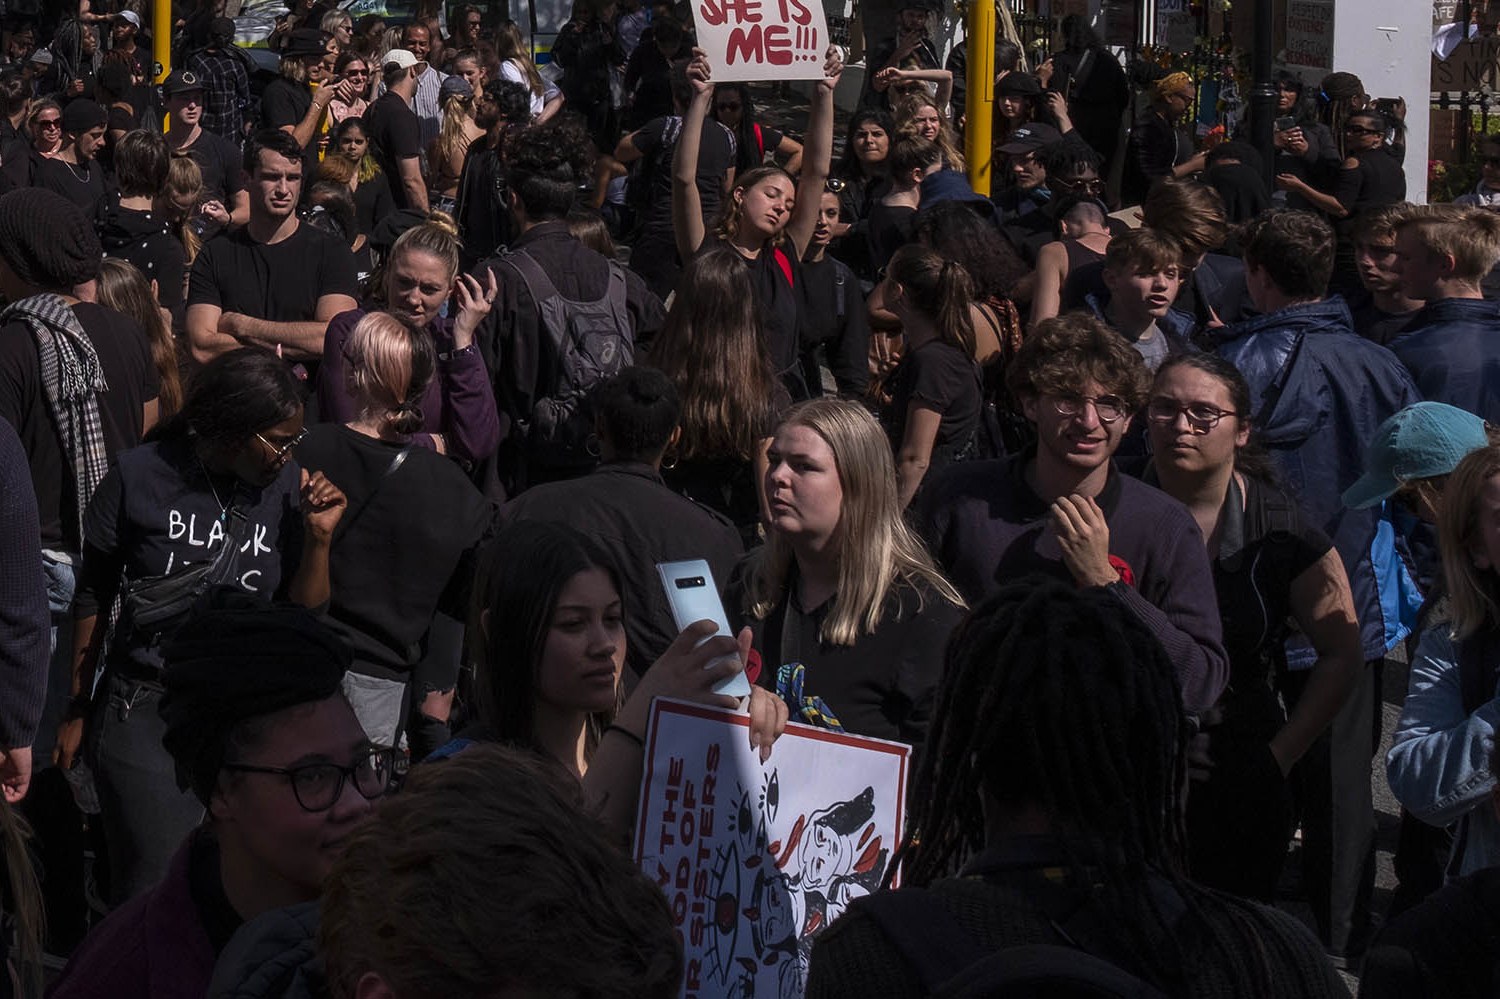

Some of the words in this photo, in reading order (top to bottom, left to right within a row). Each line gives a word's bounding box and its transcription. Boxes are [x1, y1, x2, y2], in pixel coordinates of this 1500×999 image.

[1432, 5, 1454, 20] AFE
[726, 23, 818, 66] ME!!!
[169, 509, 271, 556] BLAK
[660, 757, 684, 854] THE
[680, 779, 697, 847] OF
[690, 743, 721, 948] SISTERS
